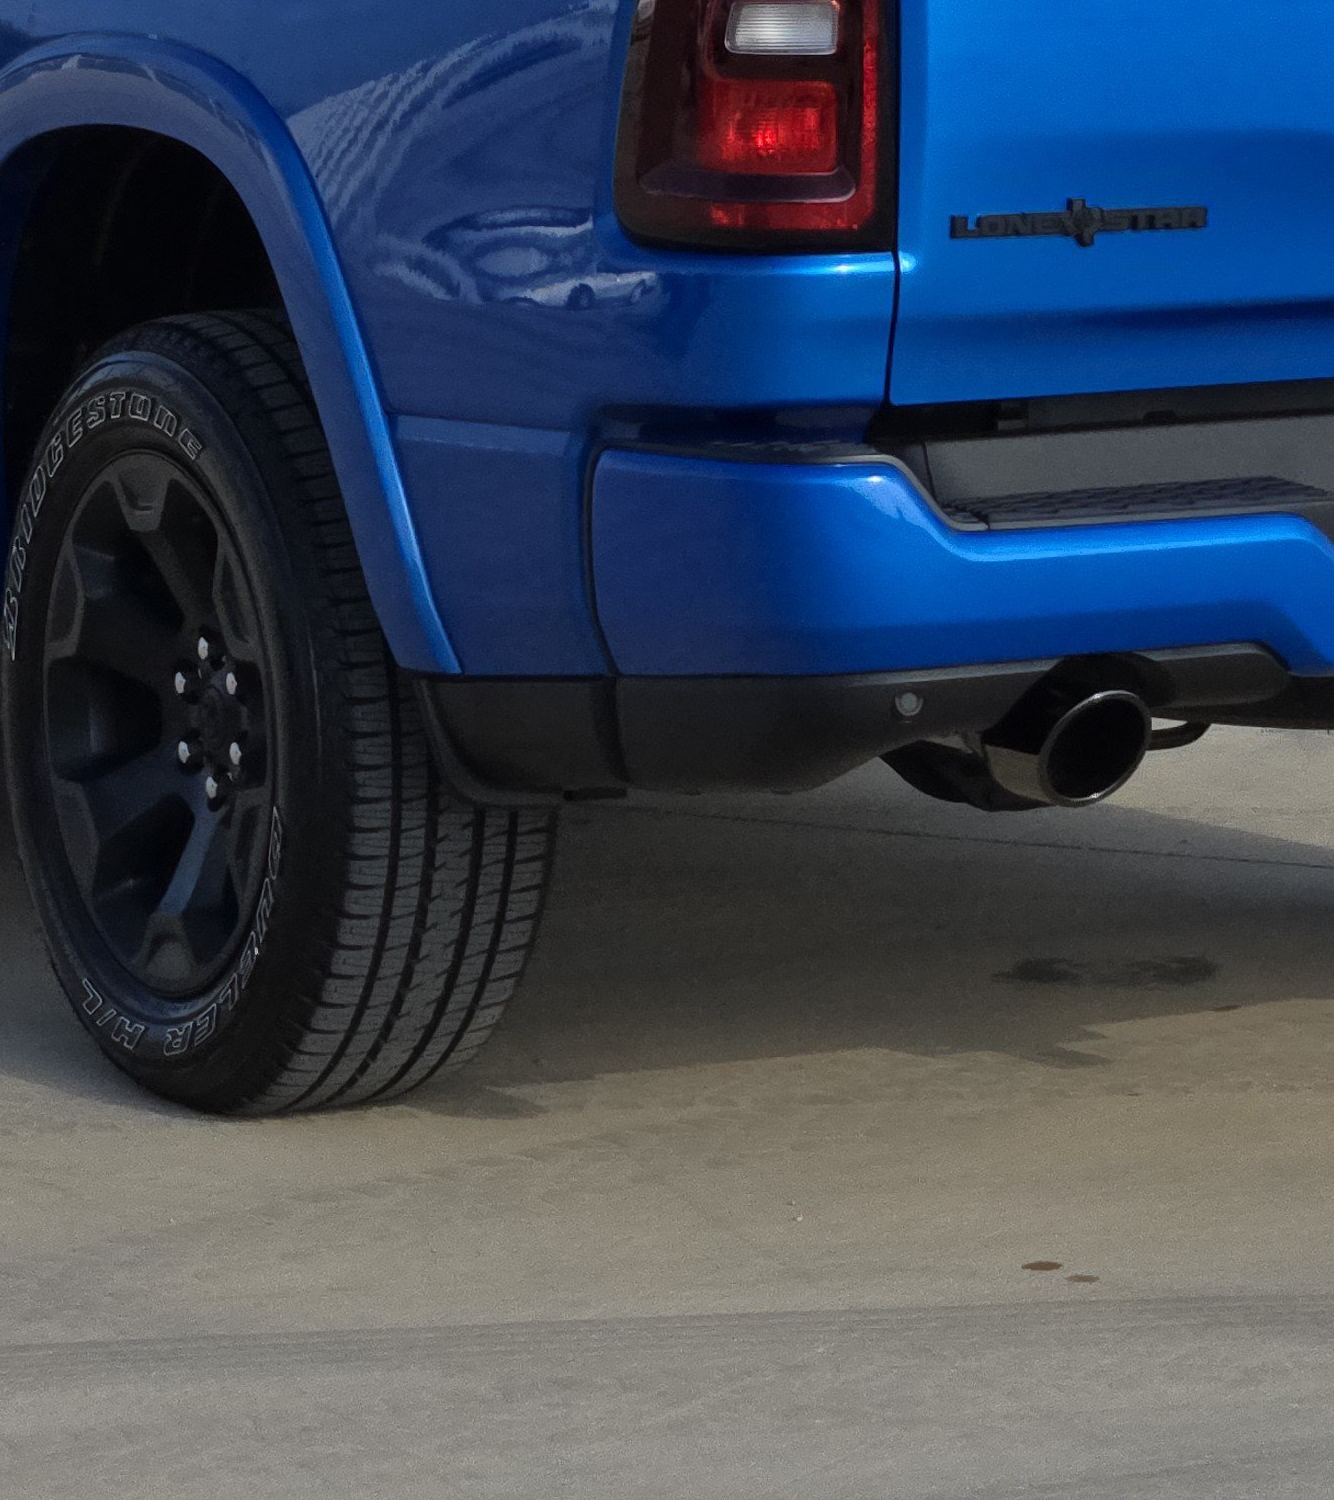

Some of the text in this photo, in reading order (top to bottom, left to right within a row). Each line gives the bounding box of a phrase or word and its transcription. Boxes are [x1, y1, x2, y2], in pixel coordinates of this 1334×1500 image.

[949, 206, 1208, 239] LONE STAR
[3, 391, 203, 662] BRIDGESTONE
[82, 978, 145, 1050] H/L
